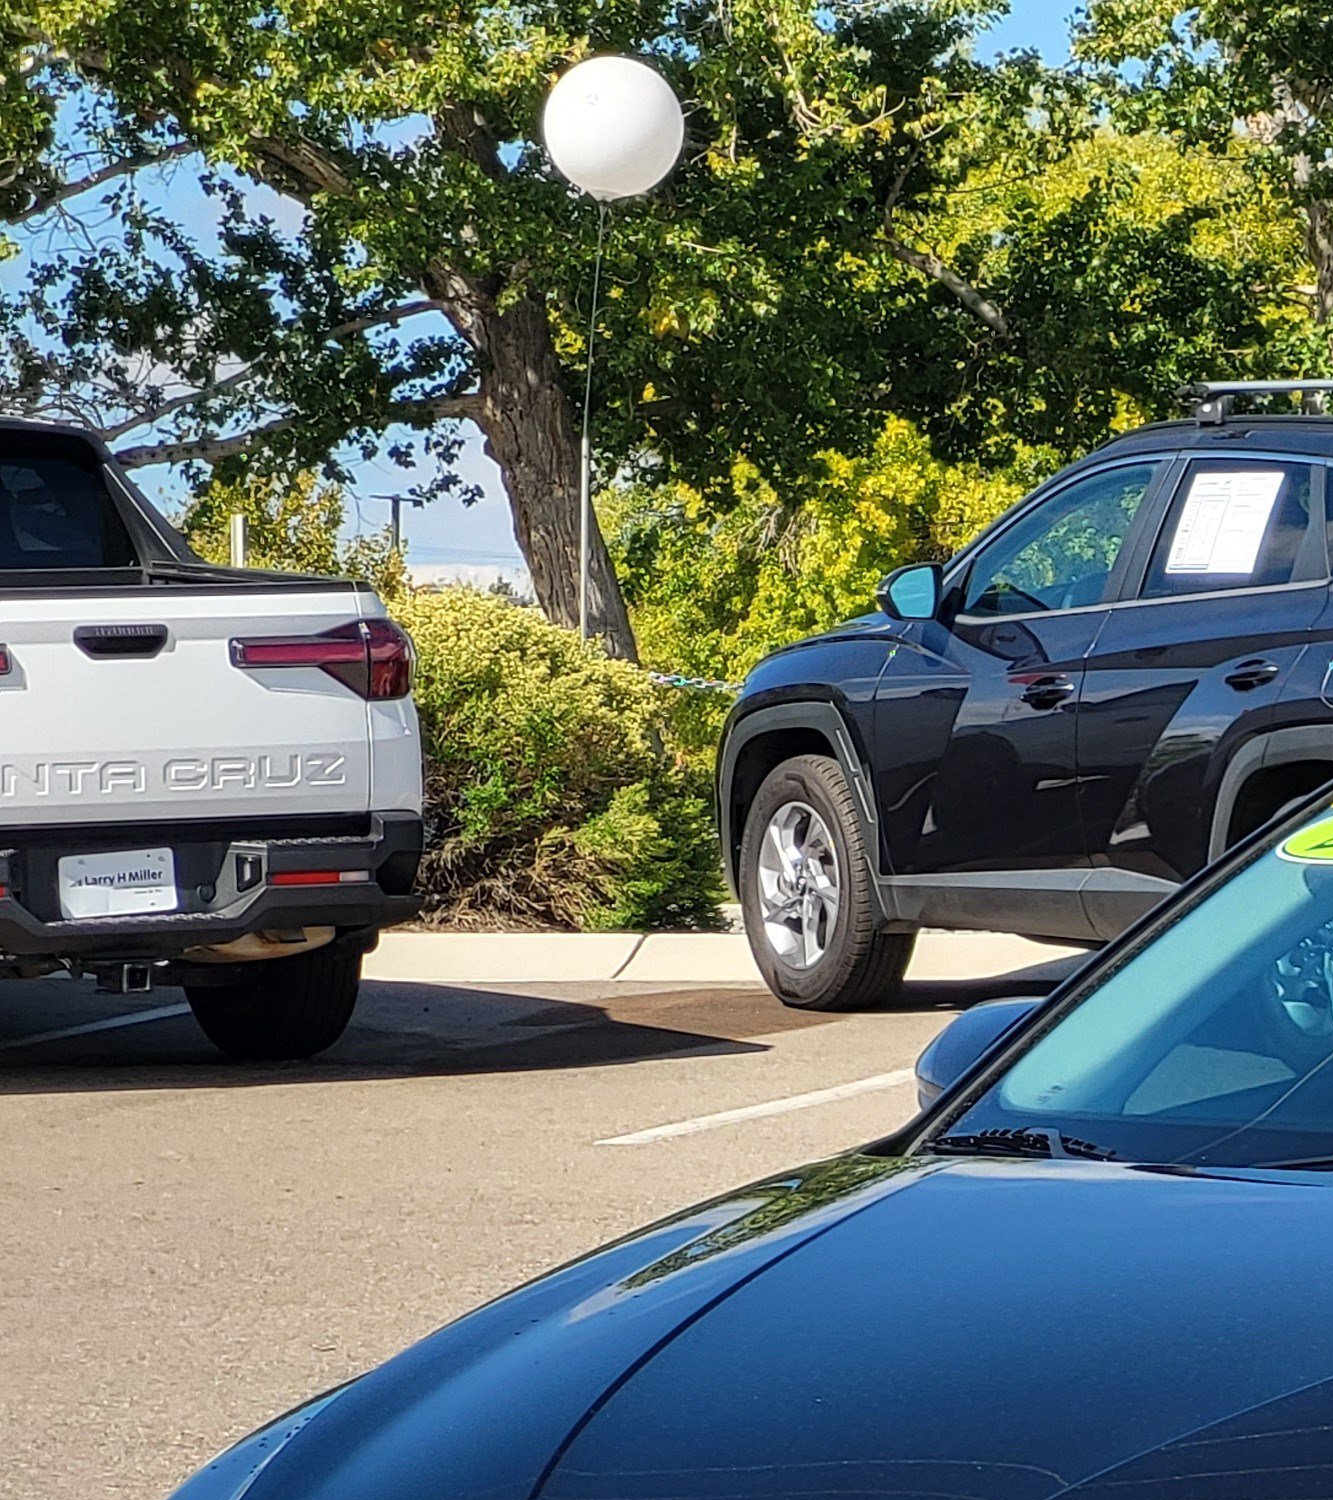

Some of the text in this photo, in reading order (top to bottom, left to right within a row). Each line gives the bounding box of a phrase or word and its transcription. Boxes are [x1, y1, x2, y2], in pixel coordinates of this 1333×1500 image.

[163, 753, 345, 791] CRUZ
[85, 870, 162, 887] Larry H Miller
